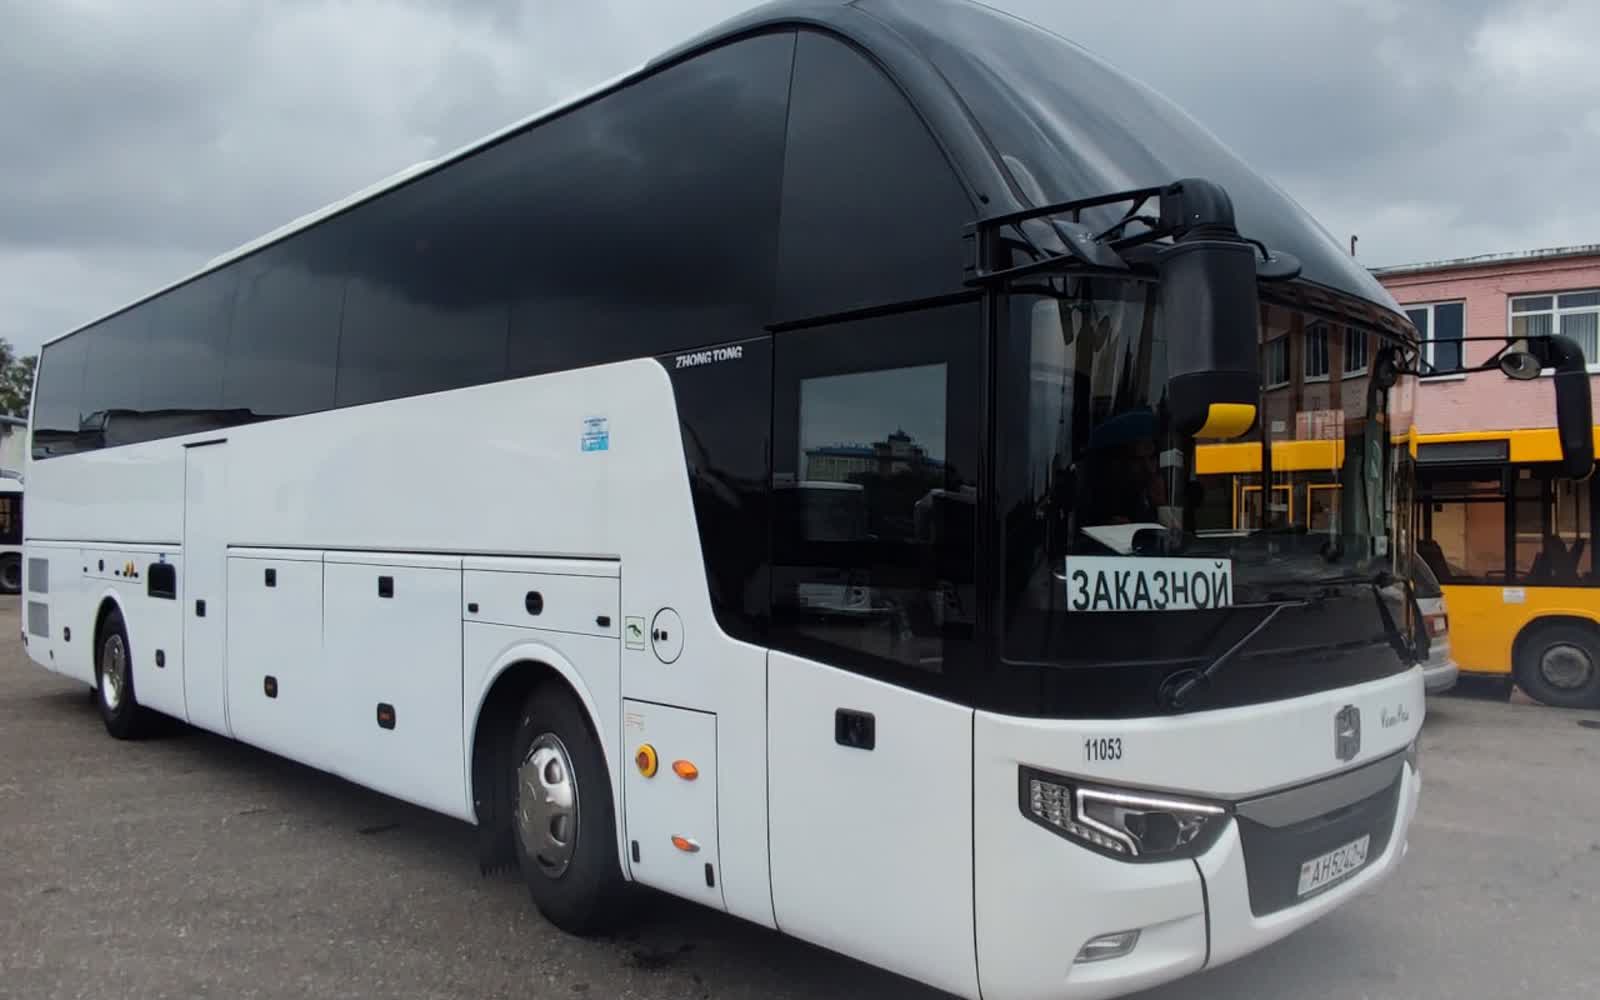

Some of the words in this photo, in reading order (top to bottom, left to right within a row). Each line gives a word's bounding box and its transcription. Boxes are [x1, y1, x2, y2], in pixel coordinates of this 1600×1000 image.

[675, 351, 712, 368] ZHONG
[713, 345, 743, 361] TONG
[1072, 561, 1229, 610] ЗАКАЗНОЙ
[1085, 738, 1122, 761] 11053
